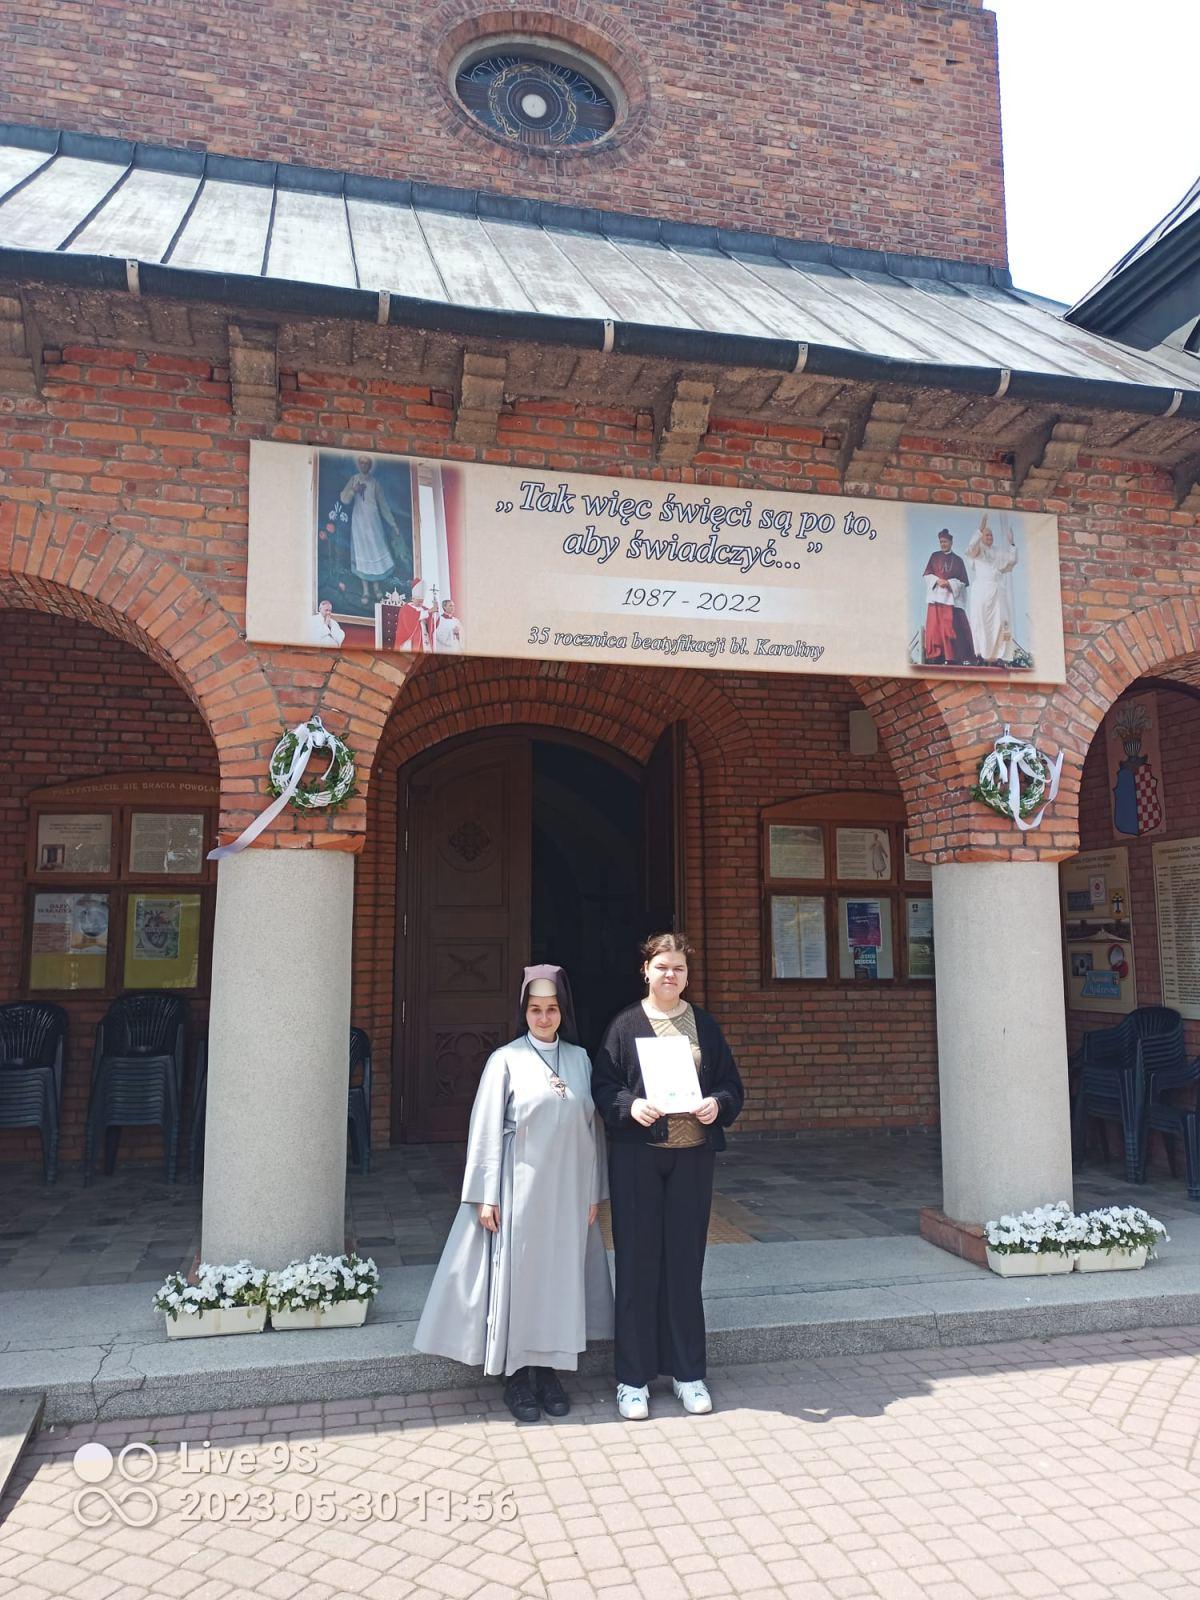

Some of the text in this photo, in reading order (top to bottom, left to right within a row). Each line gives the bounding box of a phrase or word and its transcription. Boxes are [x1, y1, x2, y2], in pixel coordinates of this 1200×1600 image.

[582, 490, 652, 525] więc
[659, 493, 752, 532] święci
[759, 509, 792, 537] są
[796, 512, 835, 539] po
[844, 511, 877, 540] to,
[563, 526, 620, 564] aby
[622, 588, 677, 607] 1987
[697, 592, 761, 612] 2022
[528, 626, 551, 644] 35
[554, 631, 628, 648] rocznica
[631, 632, 726, 657] beatyfikacji
[753, 638, 825, 662] Karoliny
